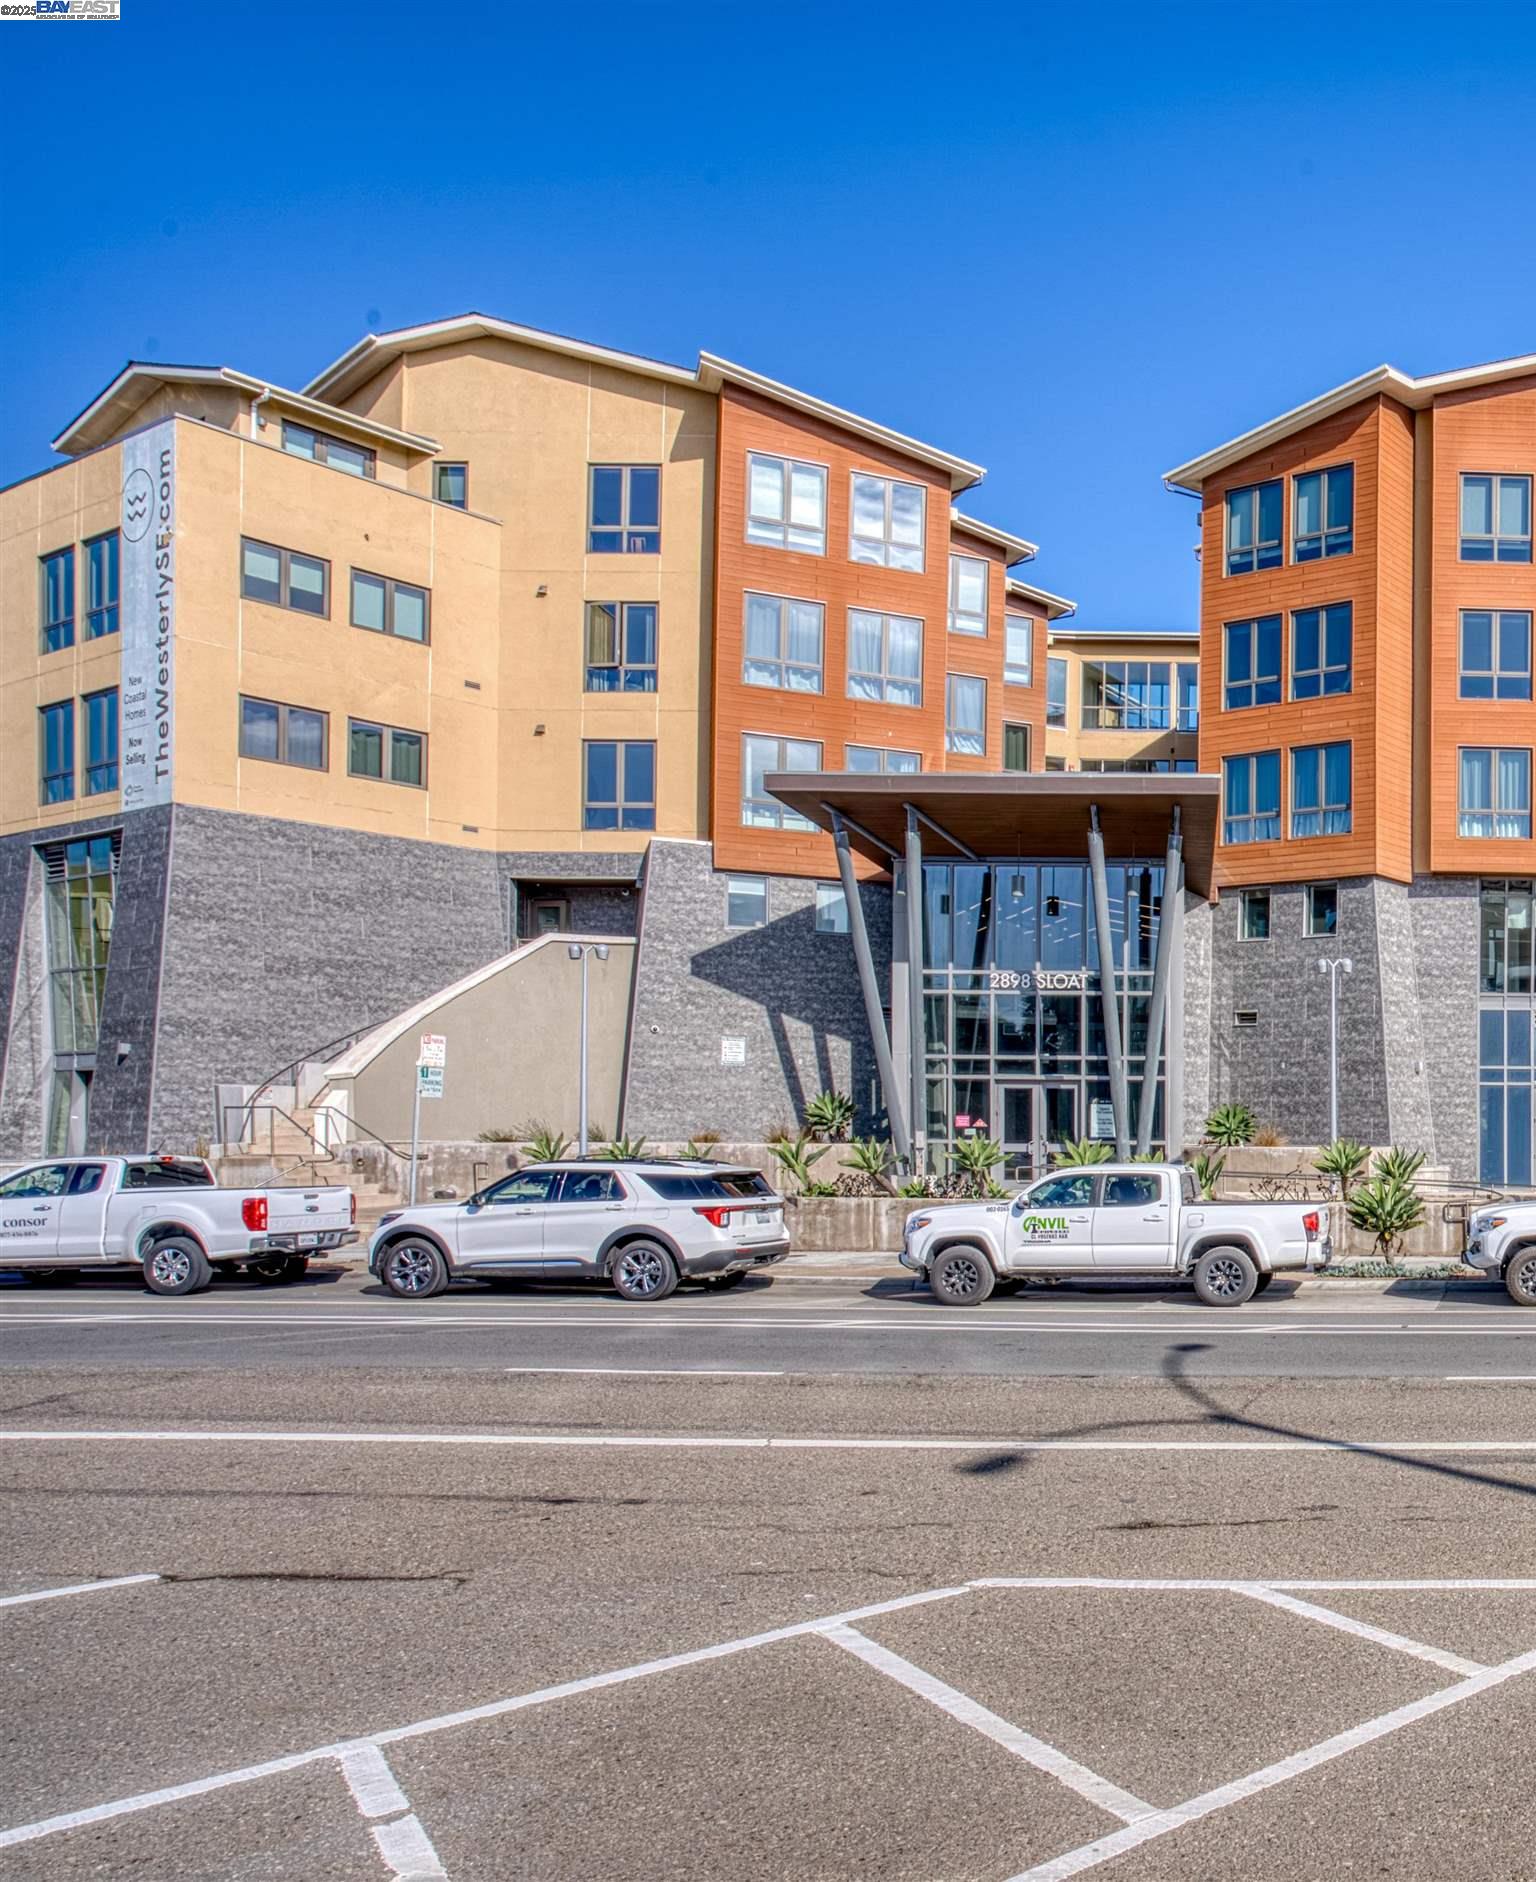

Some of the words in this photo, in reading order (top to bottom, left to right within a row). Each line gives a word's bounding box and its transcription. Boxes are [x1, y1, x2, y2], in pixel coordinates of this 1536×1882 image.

[128, 676, 142, 686] New
[125, 688, 147, 704] Coastal
[125, 708, 146, 720] Homes
[128, 737, 142, 747] Now
[126, 751, 146, 765] Selling
[990, 973, 1031, 989] 2898
[1036, 974, 1088, 989] SLOAT
[3, 1217, 48, 1228] consor
[1023, 1216, 1070, 1232] ANVIL
